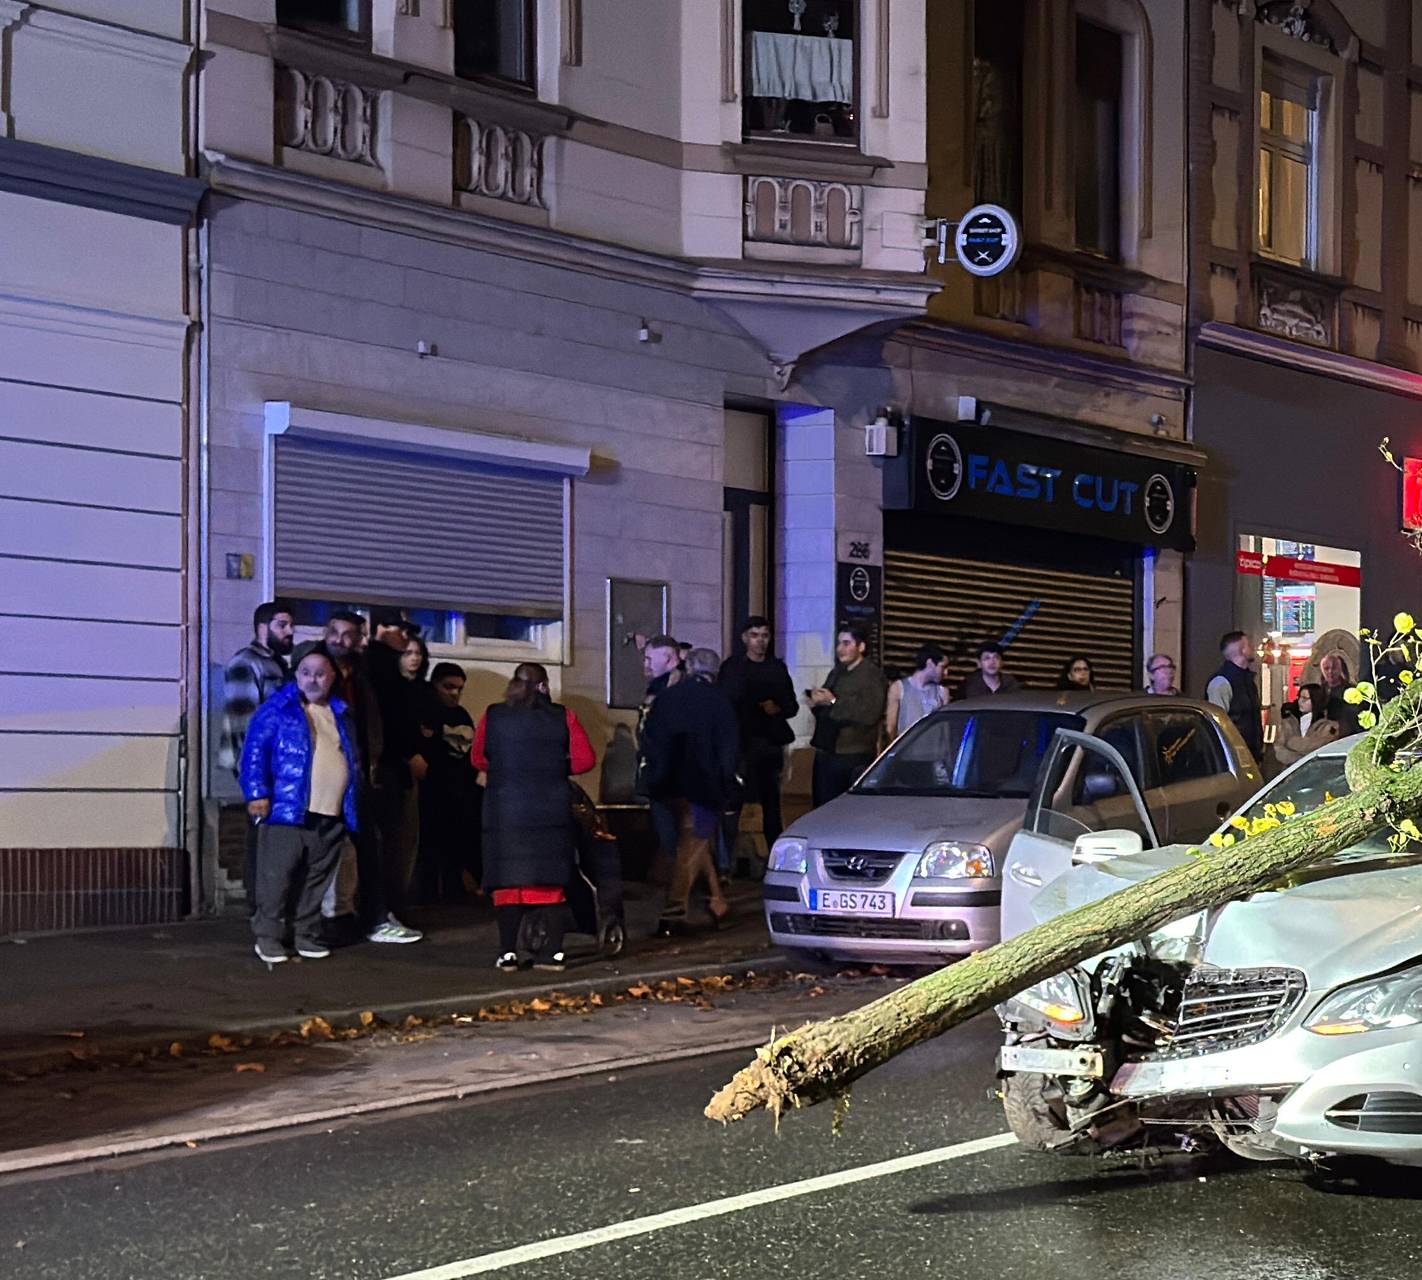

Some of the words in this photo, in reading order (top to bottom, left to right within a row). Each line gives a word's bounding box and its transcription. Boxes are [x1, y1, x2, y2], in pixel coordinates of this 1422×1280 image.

[967, 453, 1063, 503] FAST
[1072, 473, 1139, 515] CUT
[822, 893, 831, 909] E
